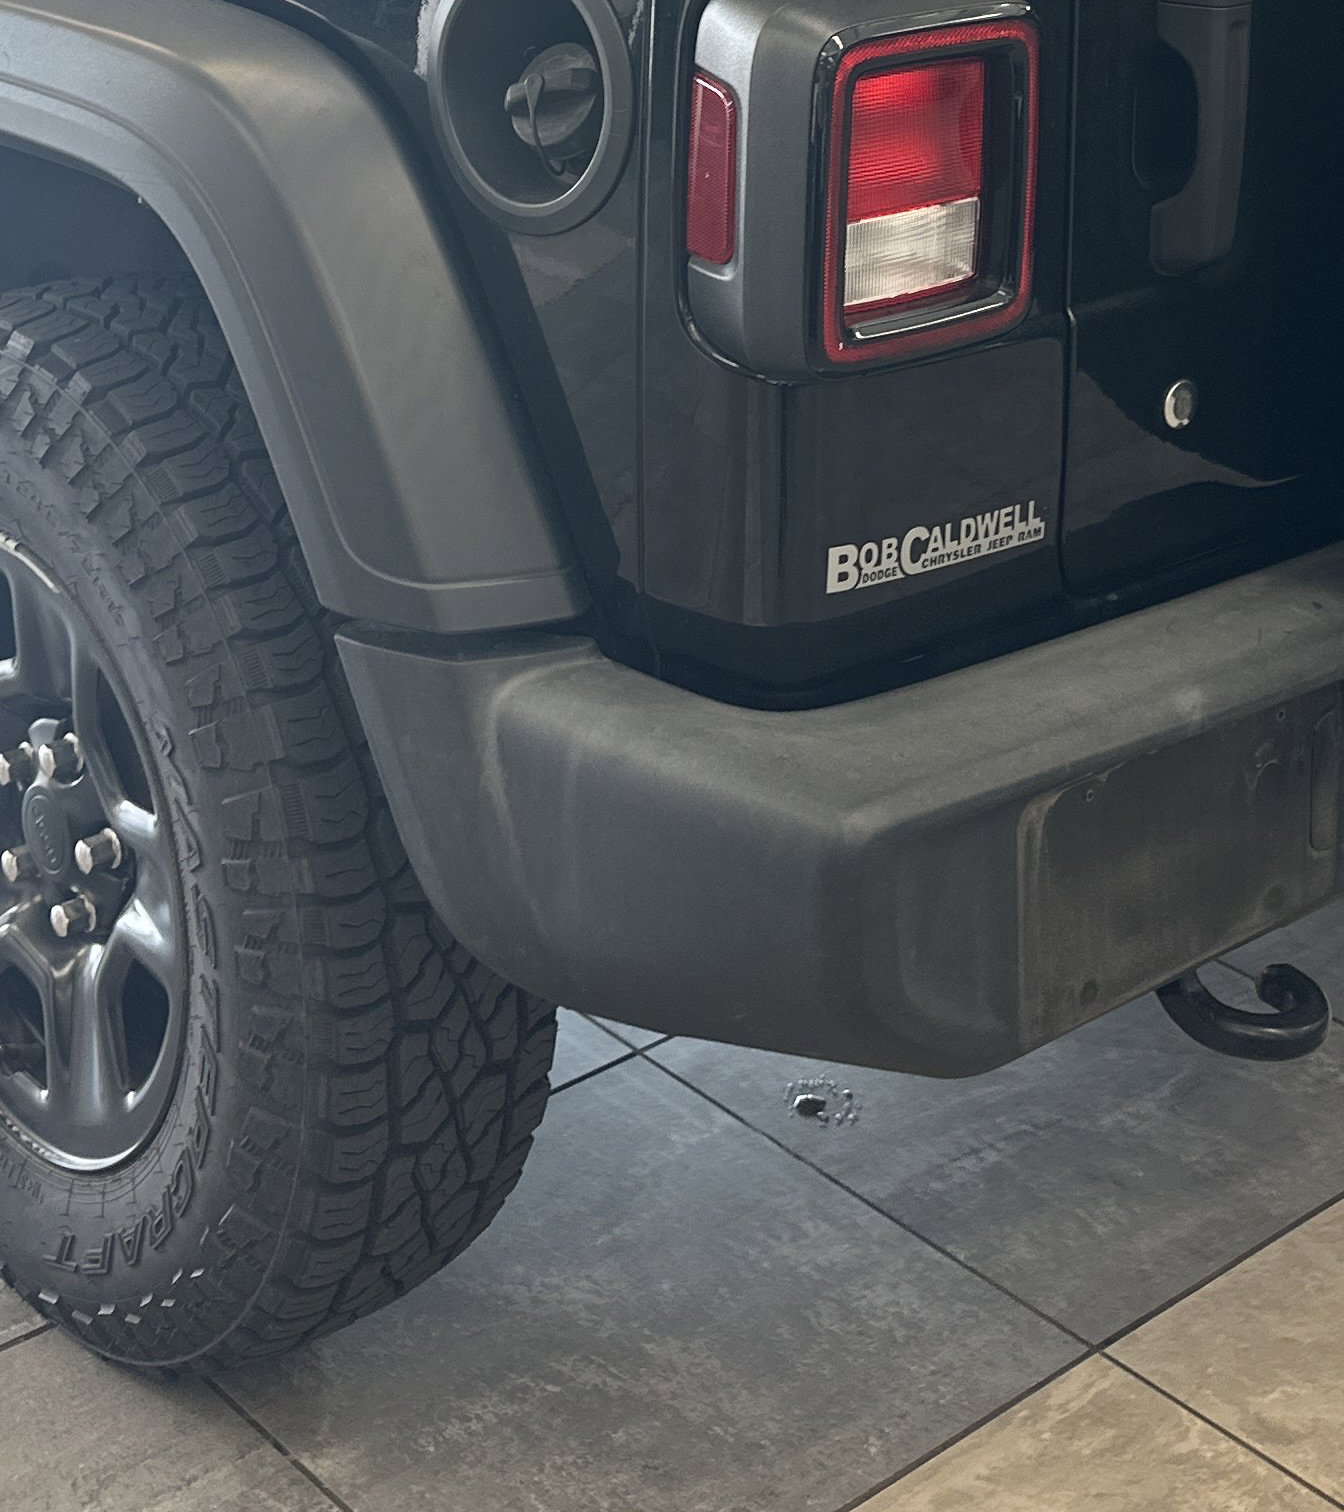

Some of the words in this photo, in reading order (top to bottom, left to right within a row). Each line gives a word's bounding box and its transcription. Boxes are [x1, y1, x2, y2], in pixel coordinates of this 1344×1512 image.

[825, 537, 899, 594] BOB
[899, 500, 1042, 576] CALDWELL
[862, 566, 898, 584] DODGE
[921, 544, 982, 569] CHRYSLER
[986, 535, 1013, 552] JEEP
[1017, 526, 1043, 543] RAM
